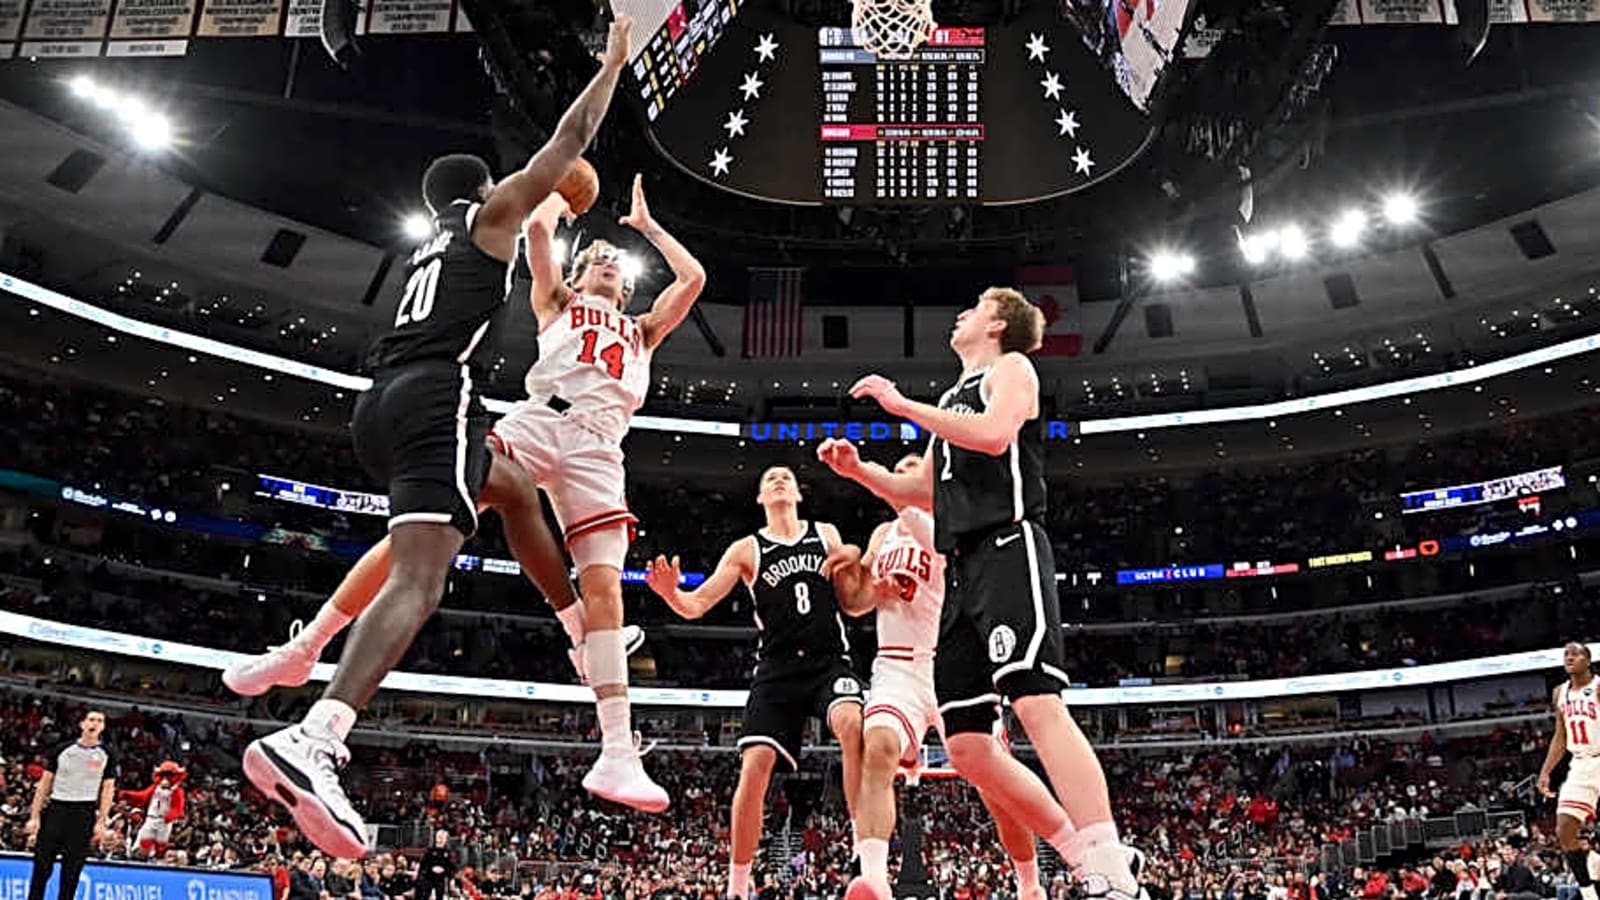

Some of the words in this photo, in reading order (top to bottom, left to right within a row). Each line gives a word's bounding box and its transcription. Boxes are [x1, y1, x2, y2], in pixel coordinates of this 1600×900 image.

[395, 257, 442, 328] 20
[570, 306, 641, 357] BULLS
[577, 330, 626, 380] 14
[751, 422, 891, 440] UNITED
[1173, 568, 1206, 578] CLUB
[794, 582, 811, 614] 8
[1570, 720, 1589, 745] 11
[94, 882, 162, 900] FANDUEL
